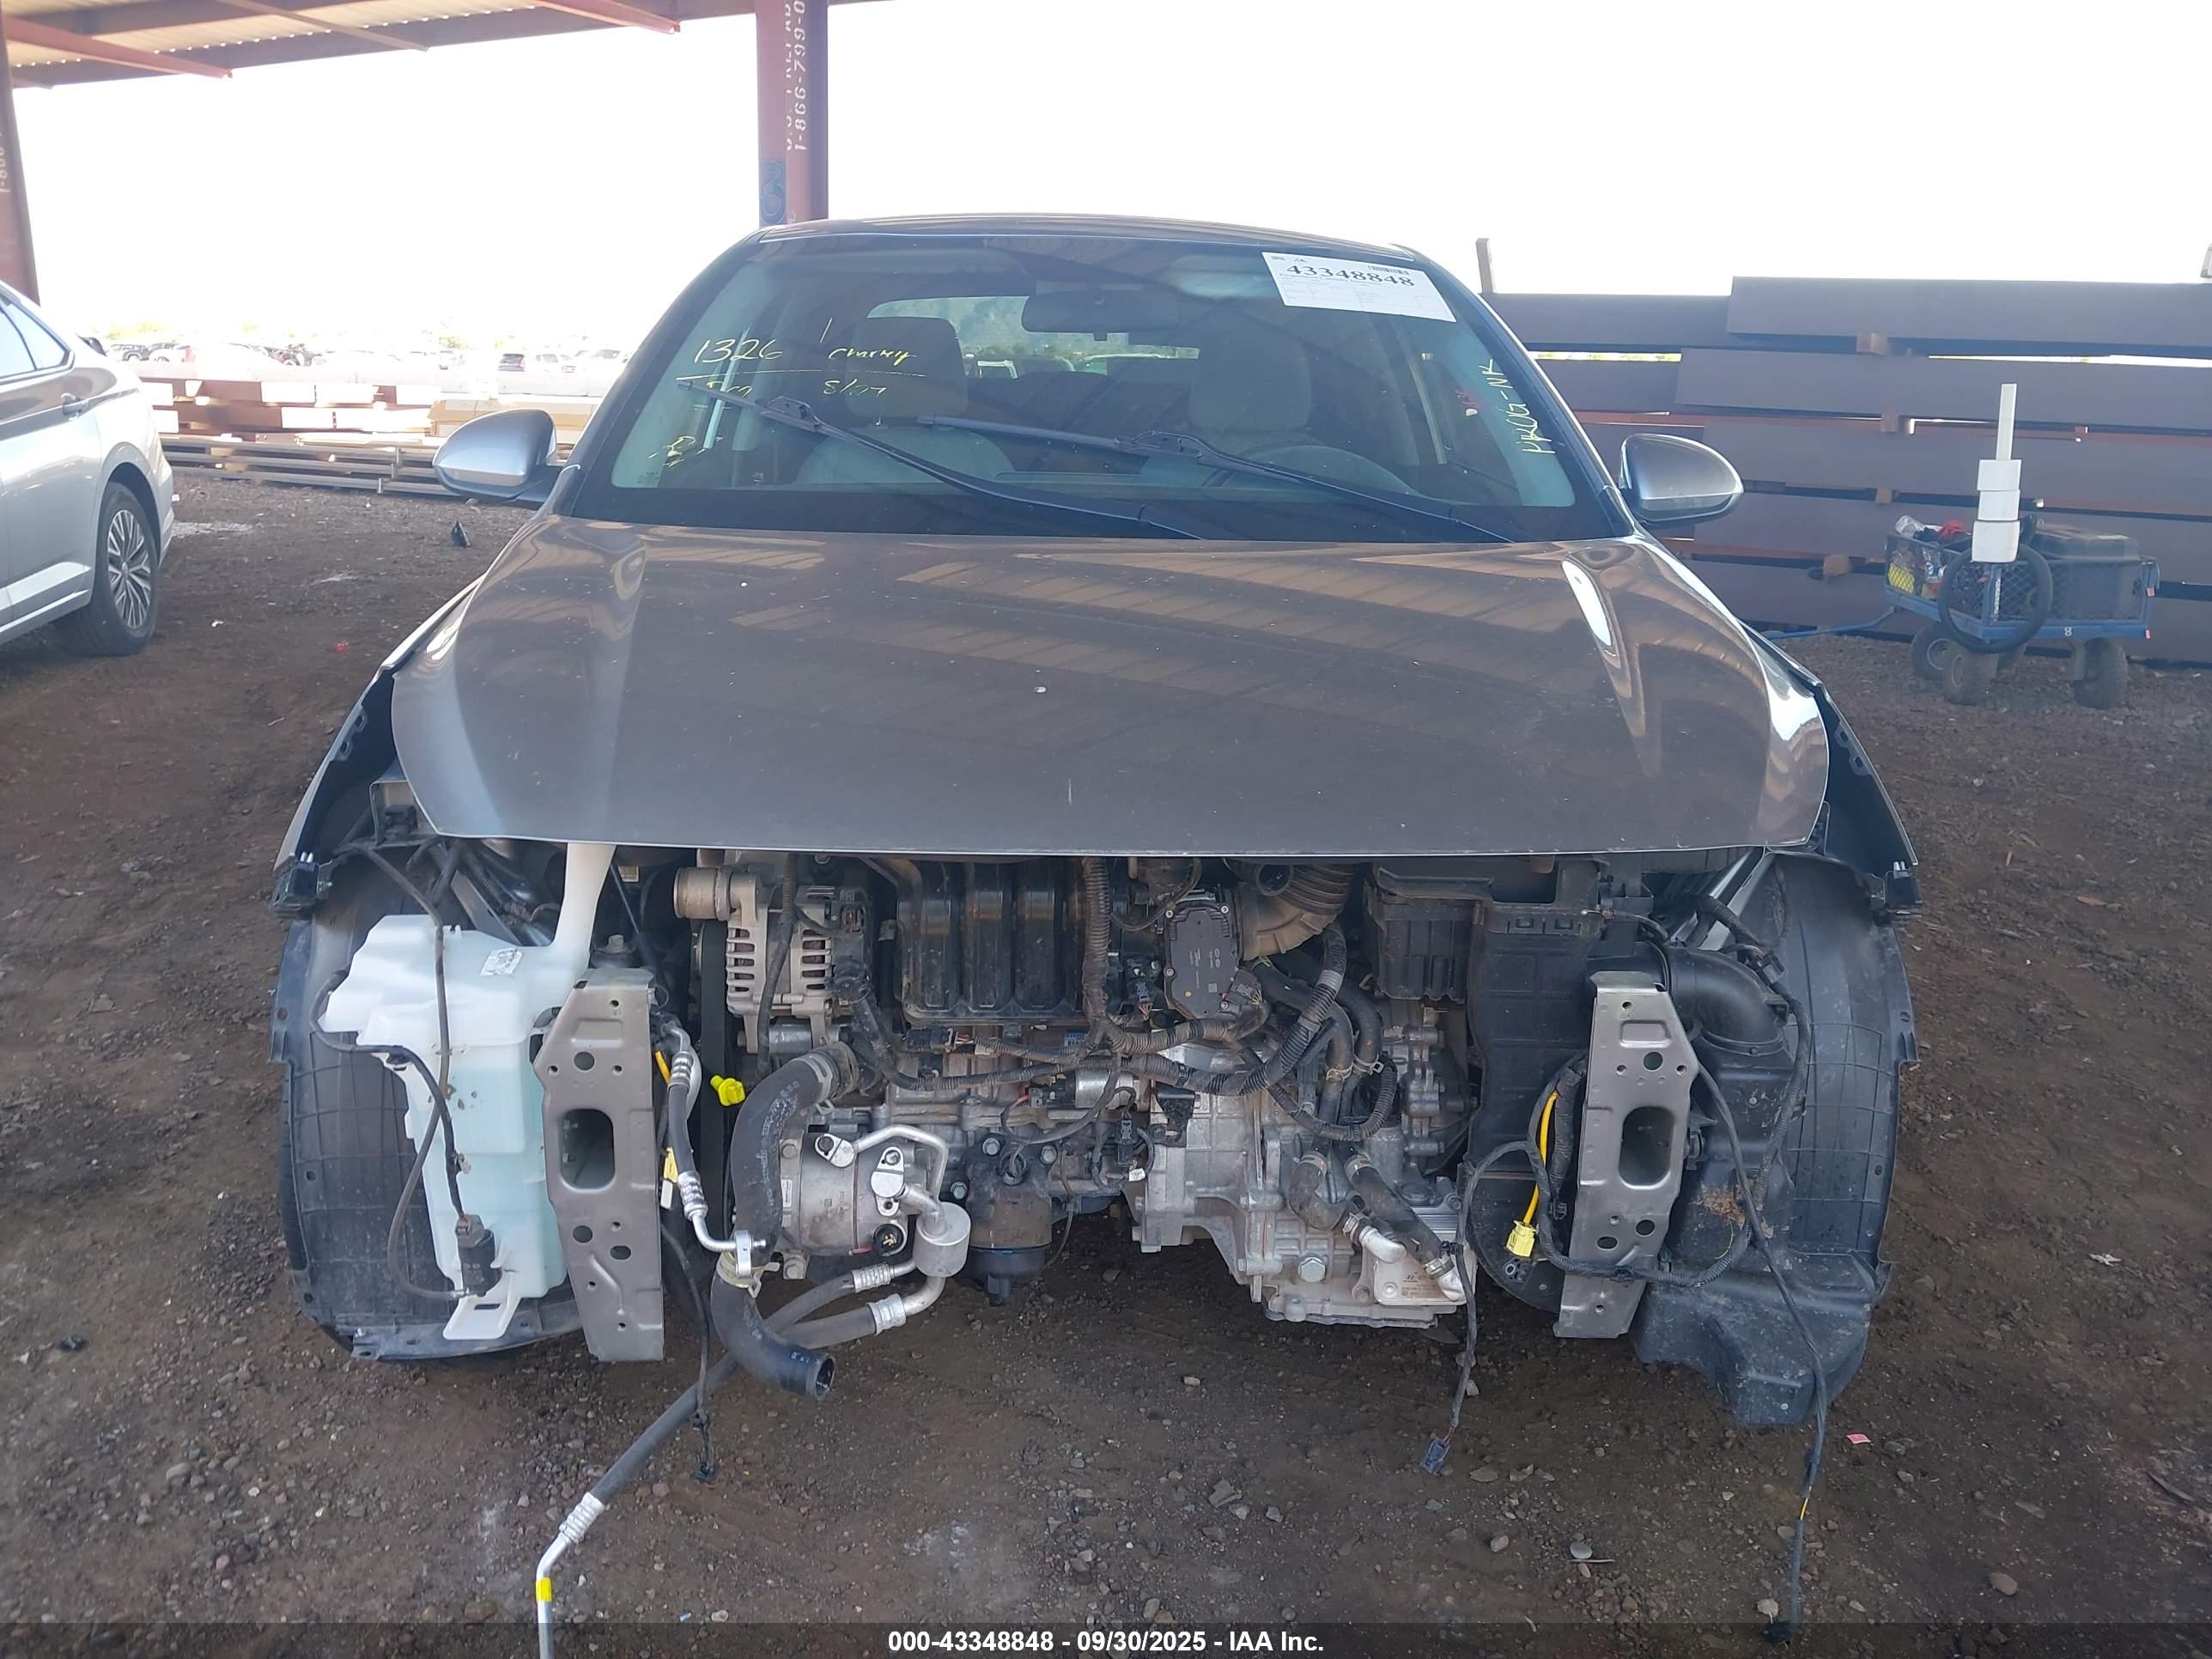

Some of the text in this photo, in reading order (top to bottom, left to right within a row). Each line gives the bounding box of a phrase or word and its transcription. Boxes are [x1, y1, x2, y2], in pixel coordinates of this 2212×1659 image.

[1286, 264, 1416, 287] 43348848
[694, 338, 783, 364] 1326
[2063, 626, 2073, 637] 8
